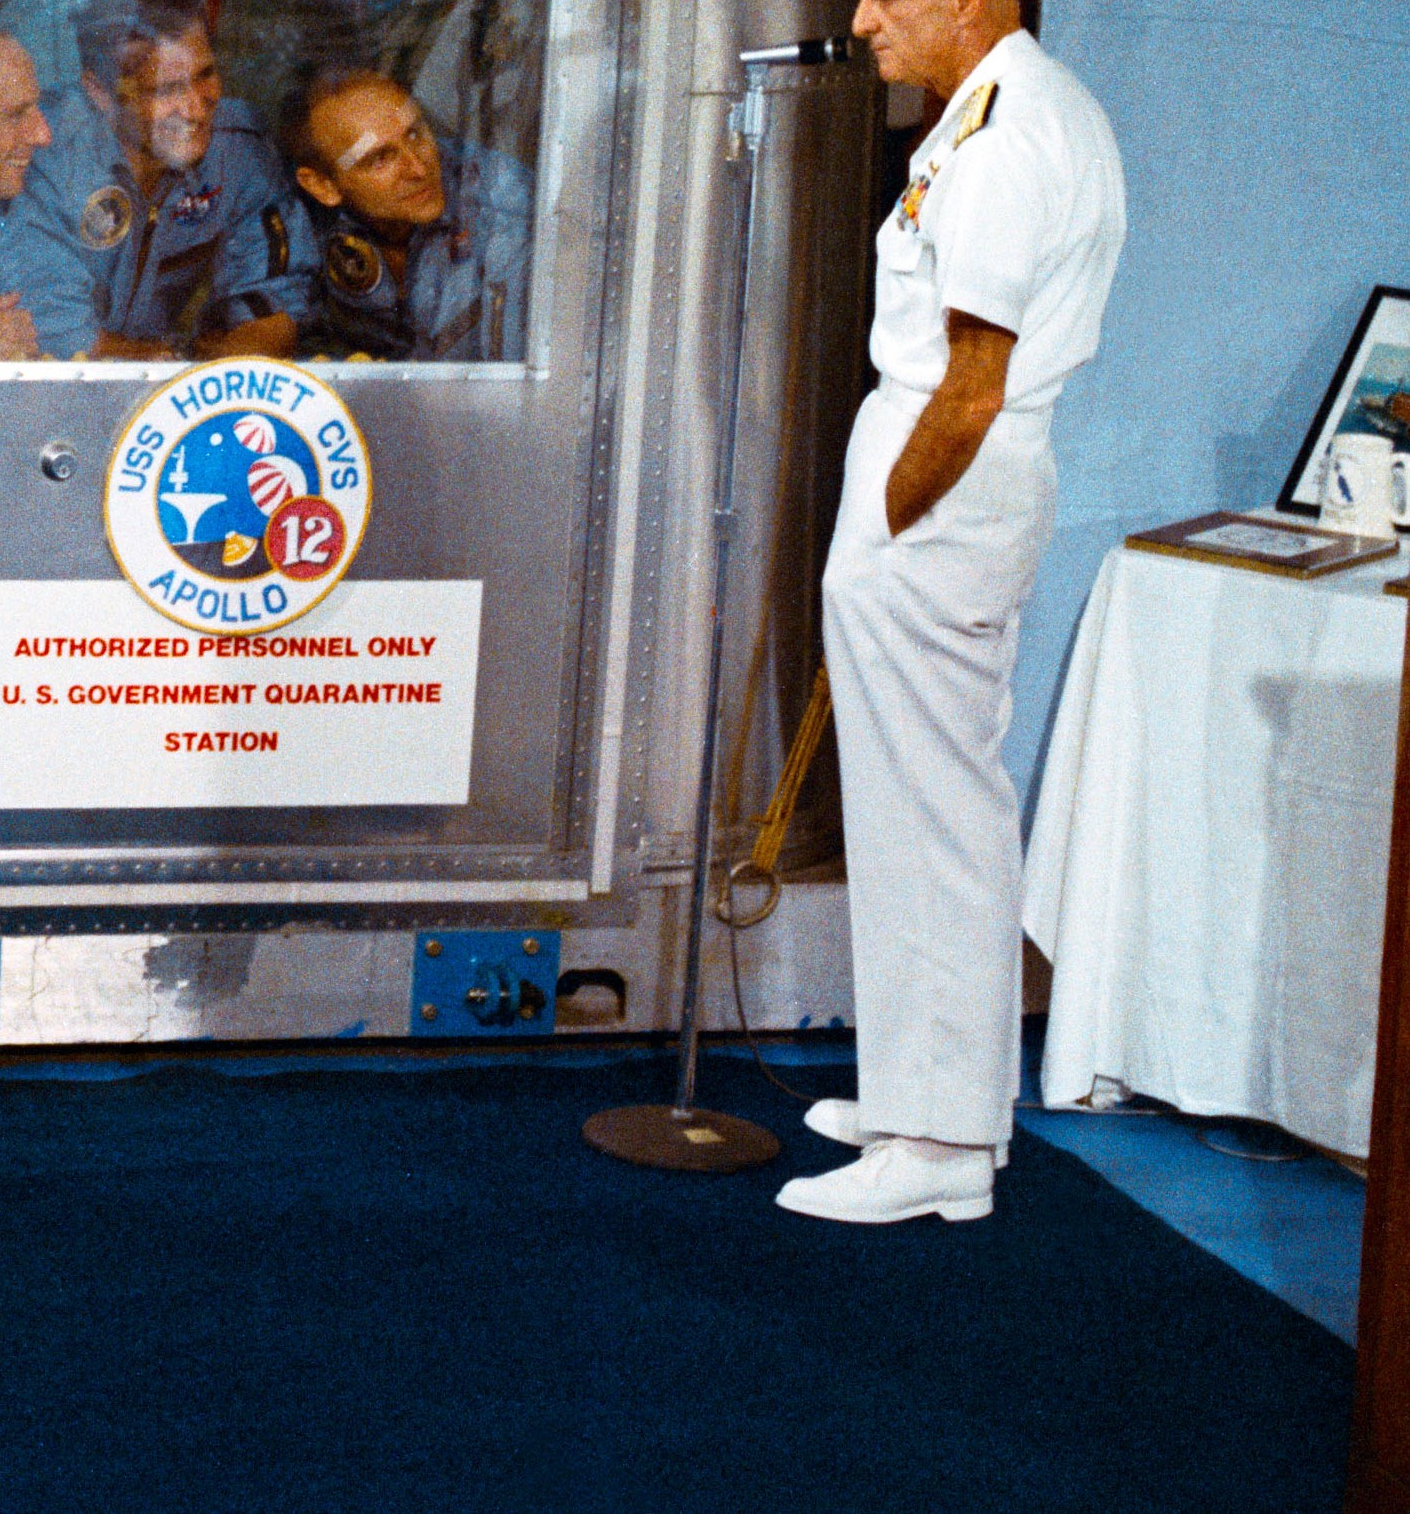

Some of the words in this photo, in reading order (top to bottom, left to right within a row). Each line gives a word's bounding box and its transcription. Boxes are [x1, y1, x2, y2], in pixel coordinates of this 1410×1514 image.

[119, 424, 164, 493] USS
[170, 371, 314, 418] HORNET
[318, 420, 358, 490] CVS
[282, 516, 333, 565] 12
[150, 570, 288, 622] APOLLO
[14, 637, 190, 658] AUTHORIZED
[197, 638, 359, 658] PERSONNEL
[366, 636, 436, 658] ONLY
[67, 684, 257, 705] GOVERNMENT
[264, 682, 442, 705] QUARANTINE
[164, 731, 279, 752] STATION
